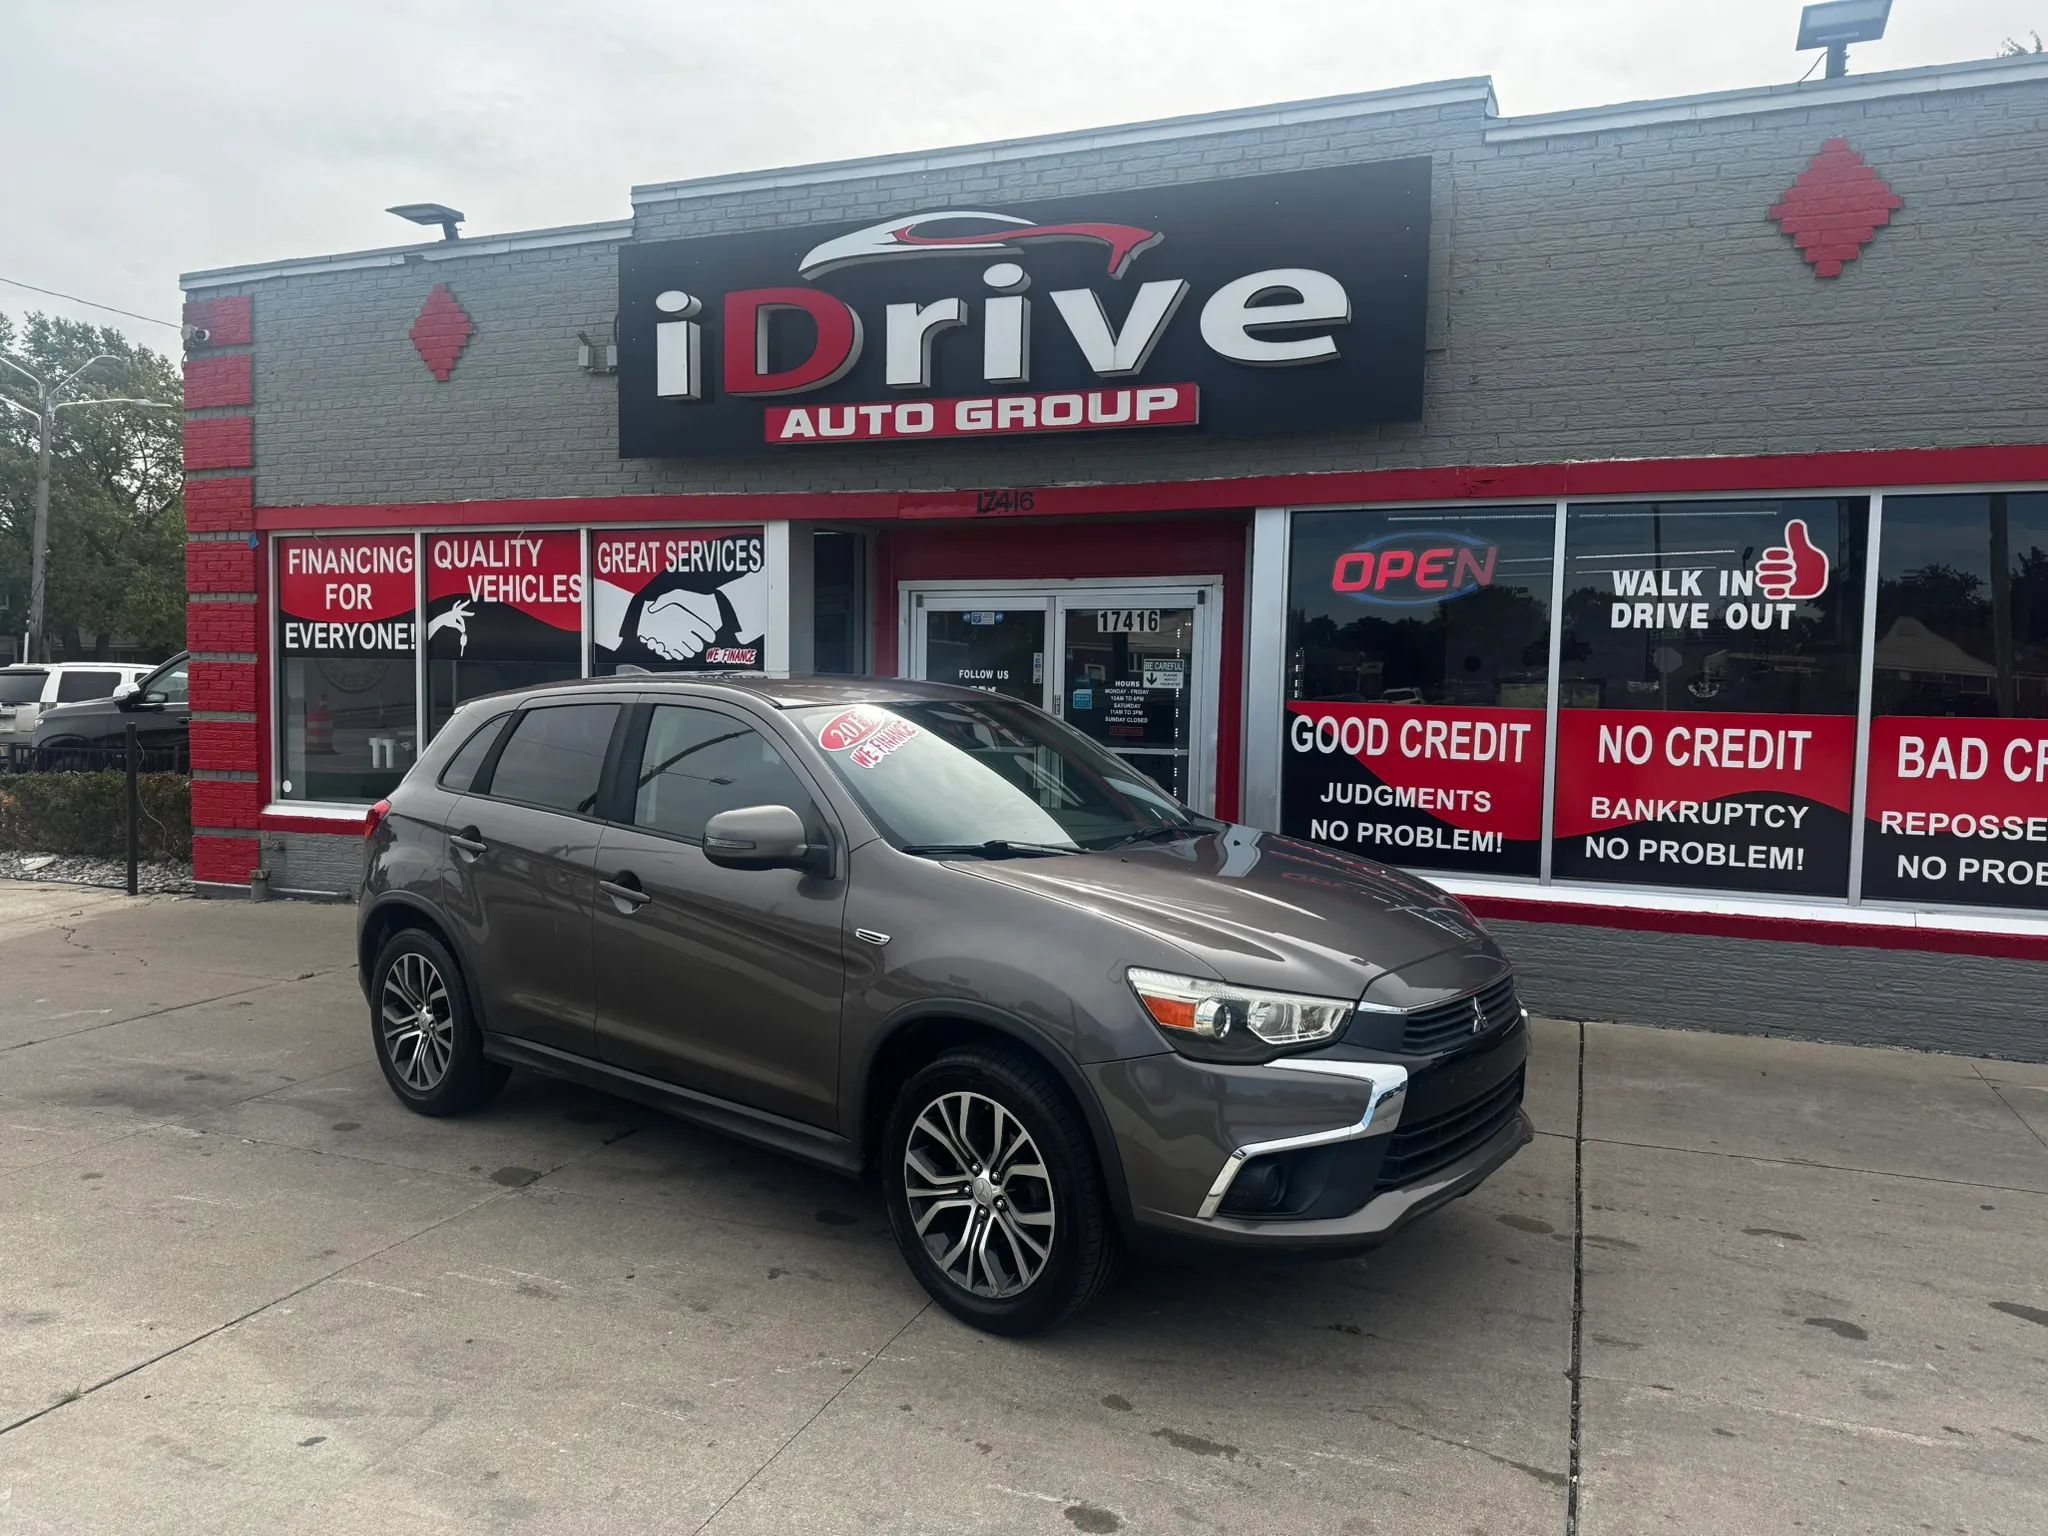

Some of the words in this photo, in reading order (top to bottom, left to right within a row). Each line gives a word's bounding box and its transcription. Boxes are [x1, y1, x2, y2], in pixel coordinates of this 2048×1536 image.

[656, 263, 1350, 400] iDrive
[779, 403, 934, 438] AUTO
[954, 387, 1179, 431] GROUP
[288, 546, 413, 575] FINANCING
[434, 539, 543, 570] QUALITY
[597, 541, 660, 574] GREAT
[665, 539, 761, 574] SERVICES
[1332, 546, 1497, 592] OPEN
[325, 583, 373, 610] FOR
[467, 574, 581, 603] VEHICLES
[1612, 570, 1703, 597] WALK
[1719, 570, 1754, 597] IN
[1100, 610, 1158, 632] 17416
[1611, 602, 1709, 629] DRIVE
[1725, 602, 1797, 631] OUT
[285, 622, 416, 650] EVERYONE!
[706, 648, 719, 662] WE
[721, 649, 756, 664] FINANCE
[1145, 661, 1154, 670] BE
[1154, 661, 1182, 671] CAREFUL
[959, 669, 993, 679] FOLLOW
[997, 670, 1009, 679] US
[851, 746, 879, 768] WE
[869, 723, 918, 754] FINANCE
[1291, 715, 1389, 756] GOOD
[1400, 719, 1531, 763] CREDIT
[1598, 724, 1653, 765] NO
[1665, 726, 1812, 771] CREDIT
[1897, 736, 1989, 780] BAD
[1320, 782, 1491, 813] JUDGMENTS
[1591, 796, 1809, 829] BANKRUPTCY
[1310, 819, 1349, 842] NO
[1357, 822, 1503, 853] PROBLEM!
[1880, 811, 2048, 842] REPOSSE
[1585, 836, 1629, 860] NO
[1639, 839, 1804, 871] PROBLEM!
[1897, 854, 1947, 880] NO
